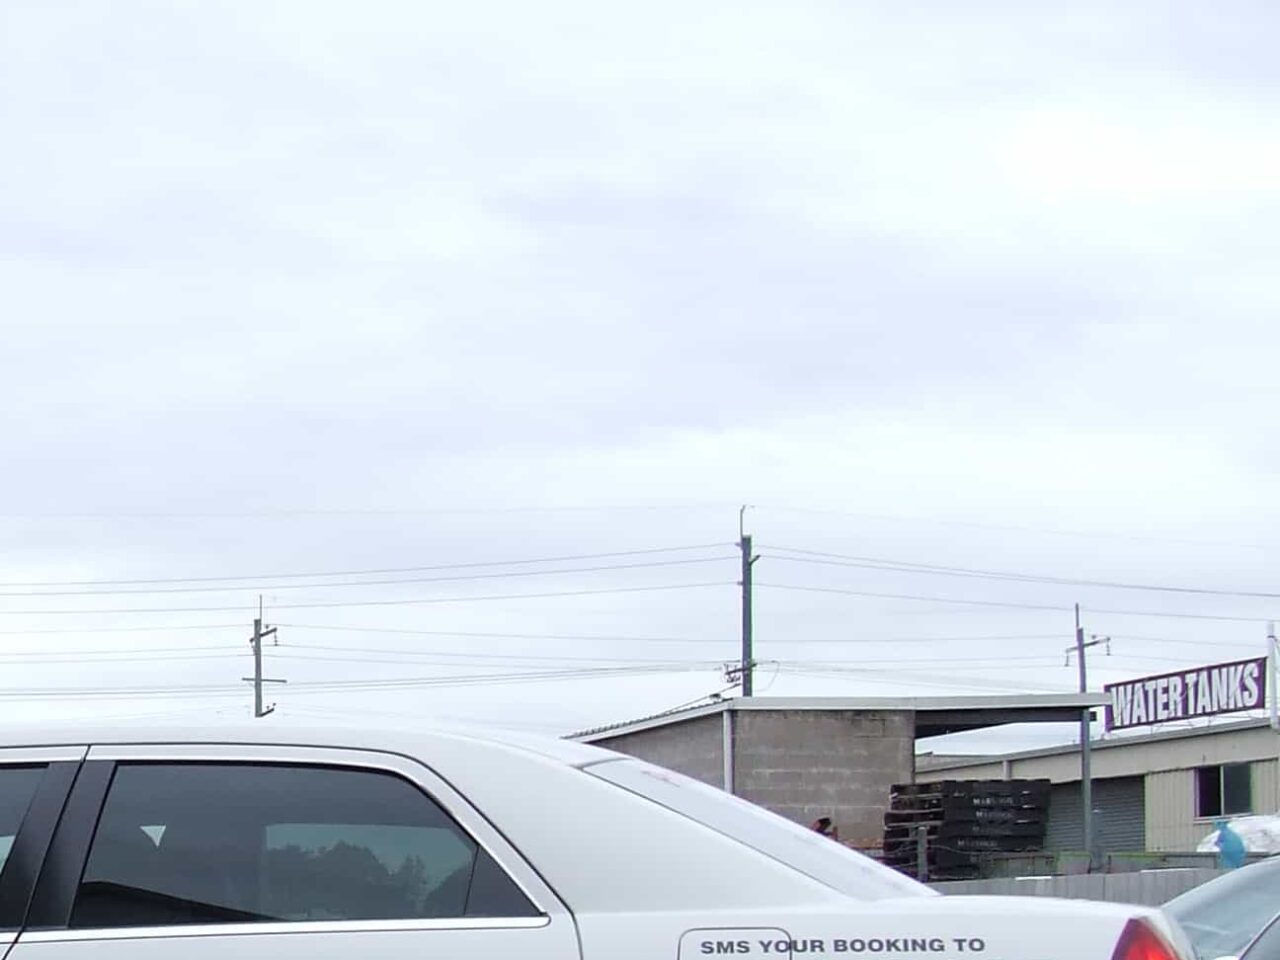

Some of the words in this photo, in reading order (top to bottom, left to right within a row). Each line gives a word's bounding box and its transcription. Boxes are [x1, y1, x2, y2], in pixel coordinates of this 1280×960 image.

[1110, 676, 1183, 727] WATER
[1185, 662, 1259, 715] TANKS
[700, 941, 751, 954] SMS
[758, 939, 825, 954] YOUR
[833, 938, 945, 953] BOOKING
[953, 937, 986, 952] TO
